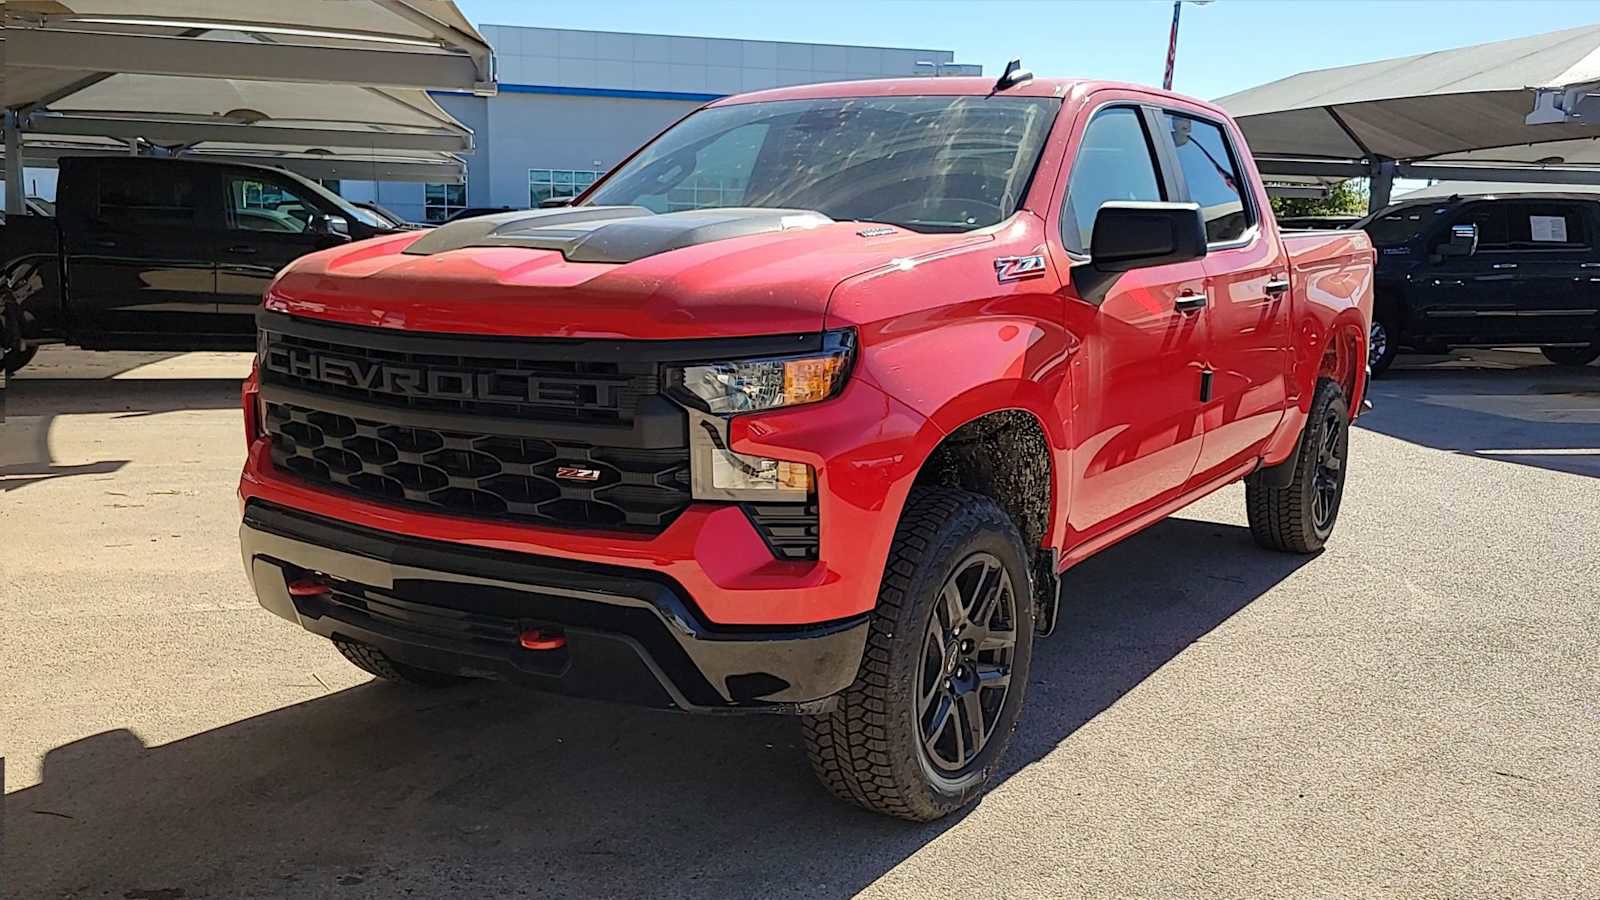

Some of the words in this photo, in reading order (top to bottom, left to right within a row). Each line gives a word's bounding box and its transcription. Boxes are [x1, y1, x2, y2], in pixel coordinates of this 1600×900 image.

[994, 255, 1046, 283] Z71
[264, 348, 630, 409] CHEVROLET
[556, 466, 601, 480] Z71
